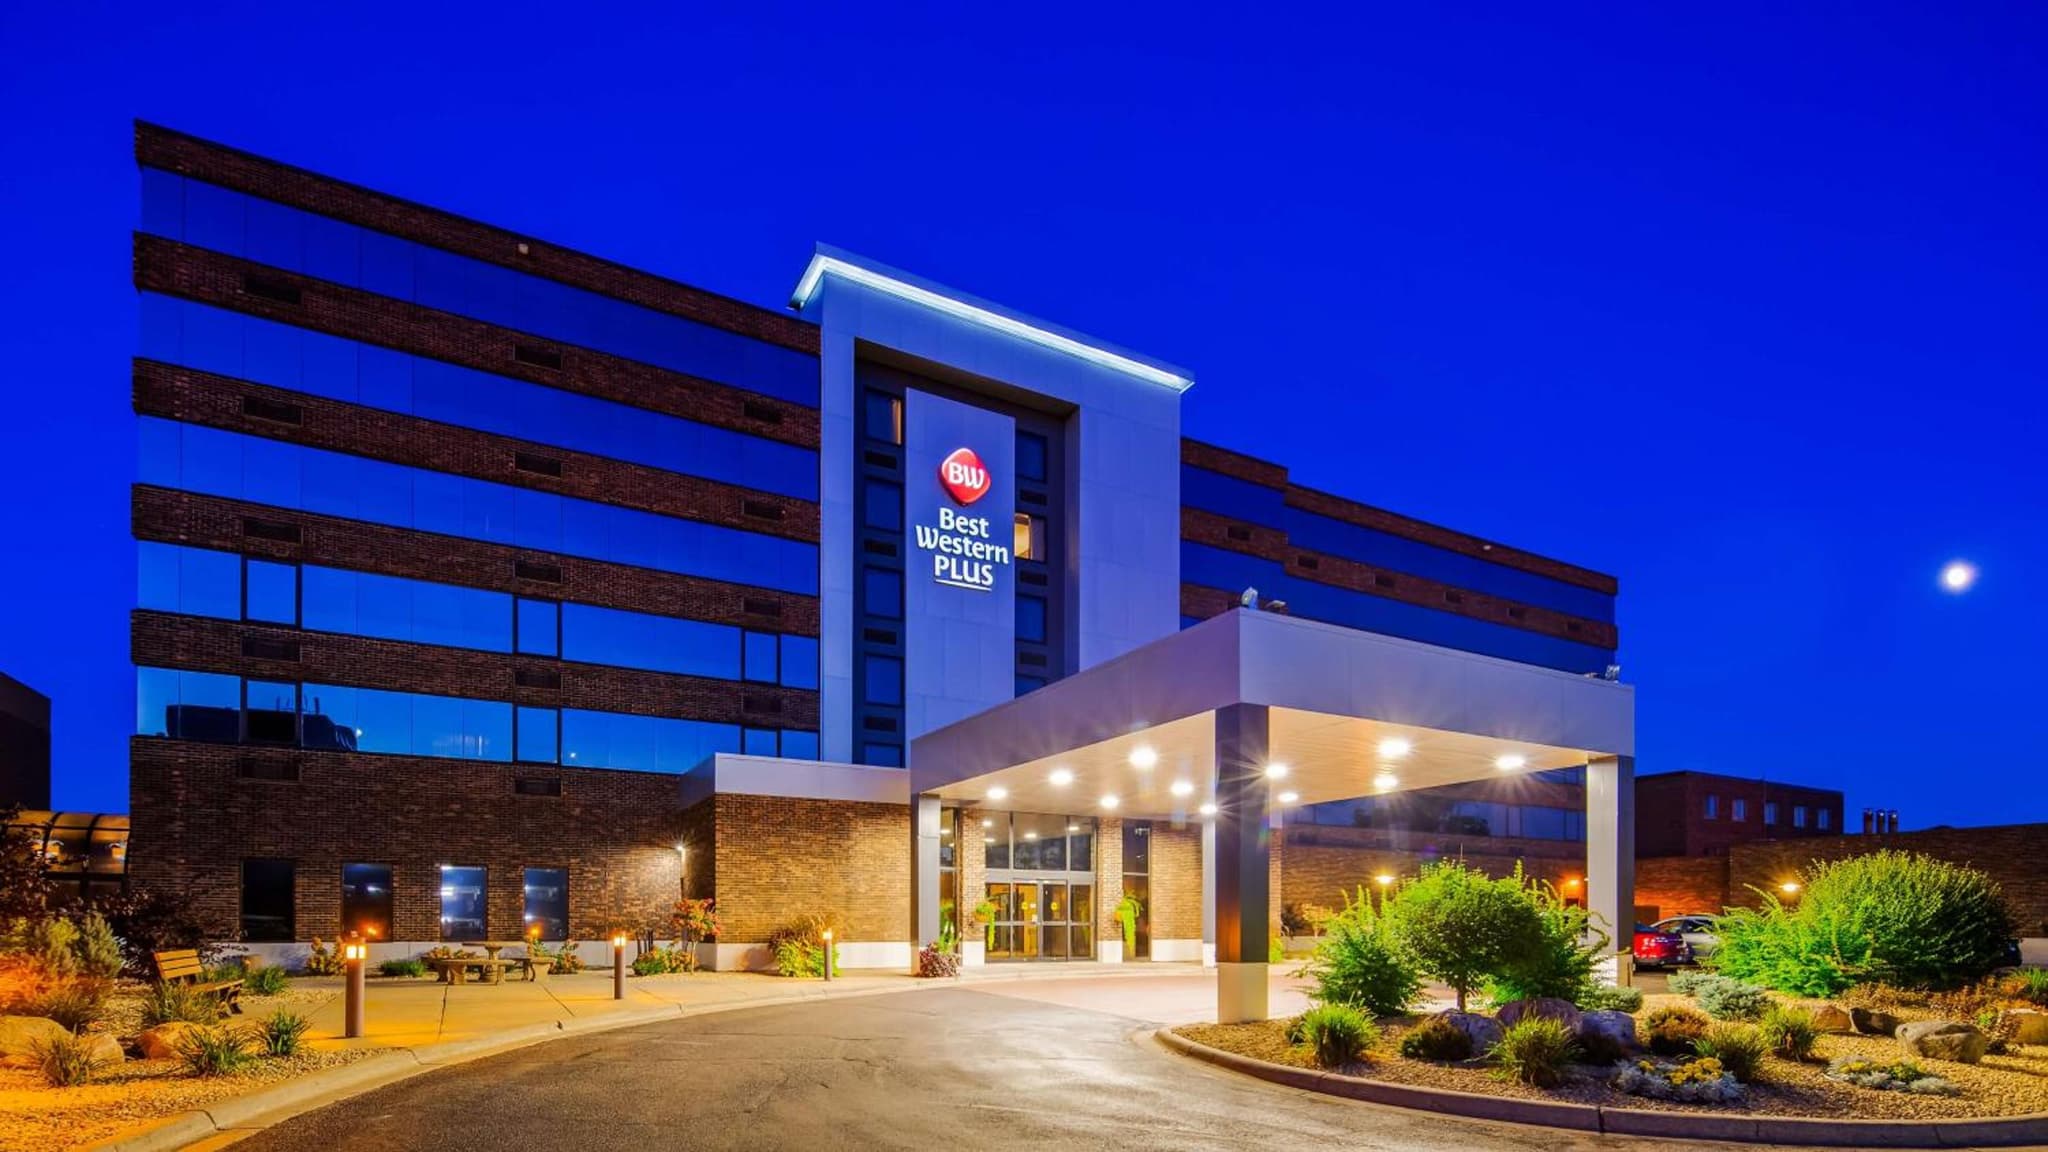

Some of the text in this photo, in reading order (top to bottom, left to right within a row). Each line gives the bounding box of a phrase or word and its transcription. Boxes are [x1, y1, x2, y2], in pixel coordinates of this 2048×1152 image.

[949, 462, 985, 489] BW
[939, 507, 989, 538] Best
[915, 525, 1009, 564] Western
[934, 555, 994, 586] PLUS
